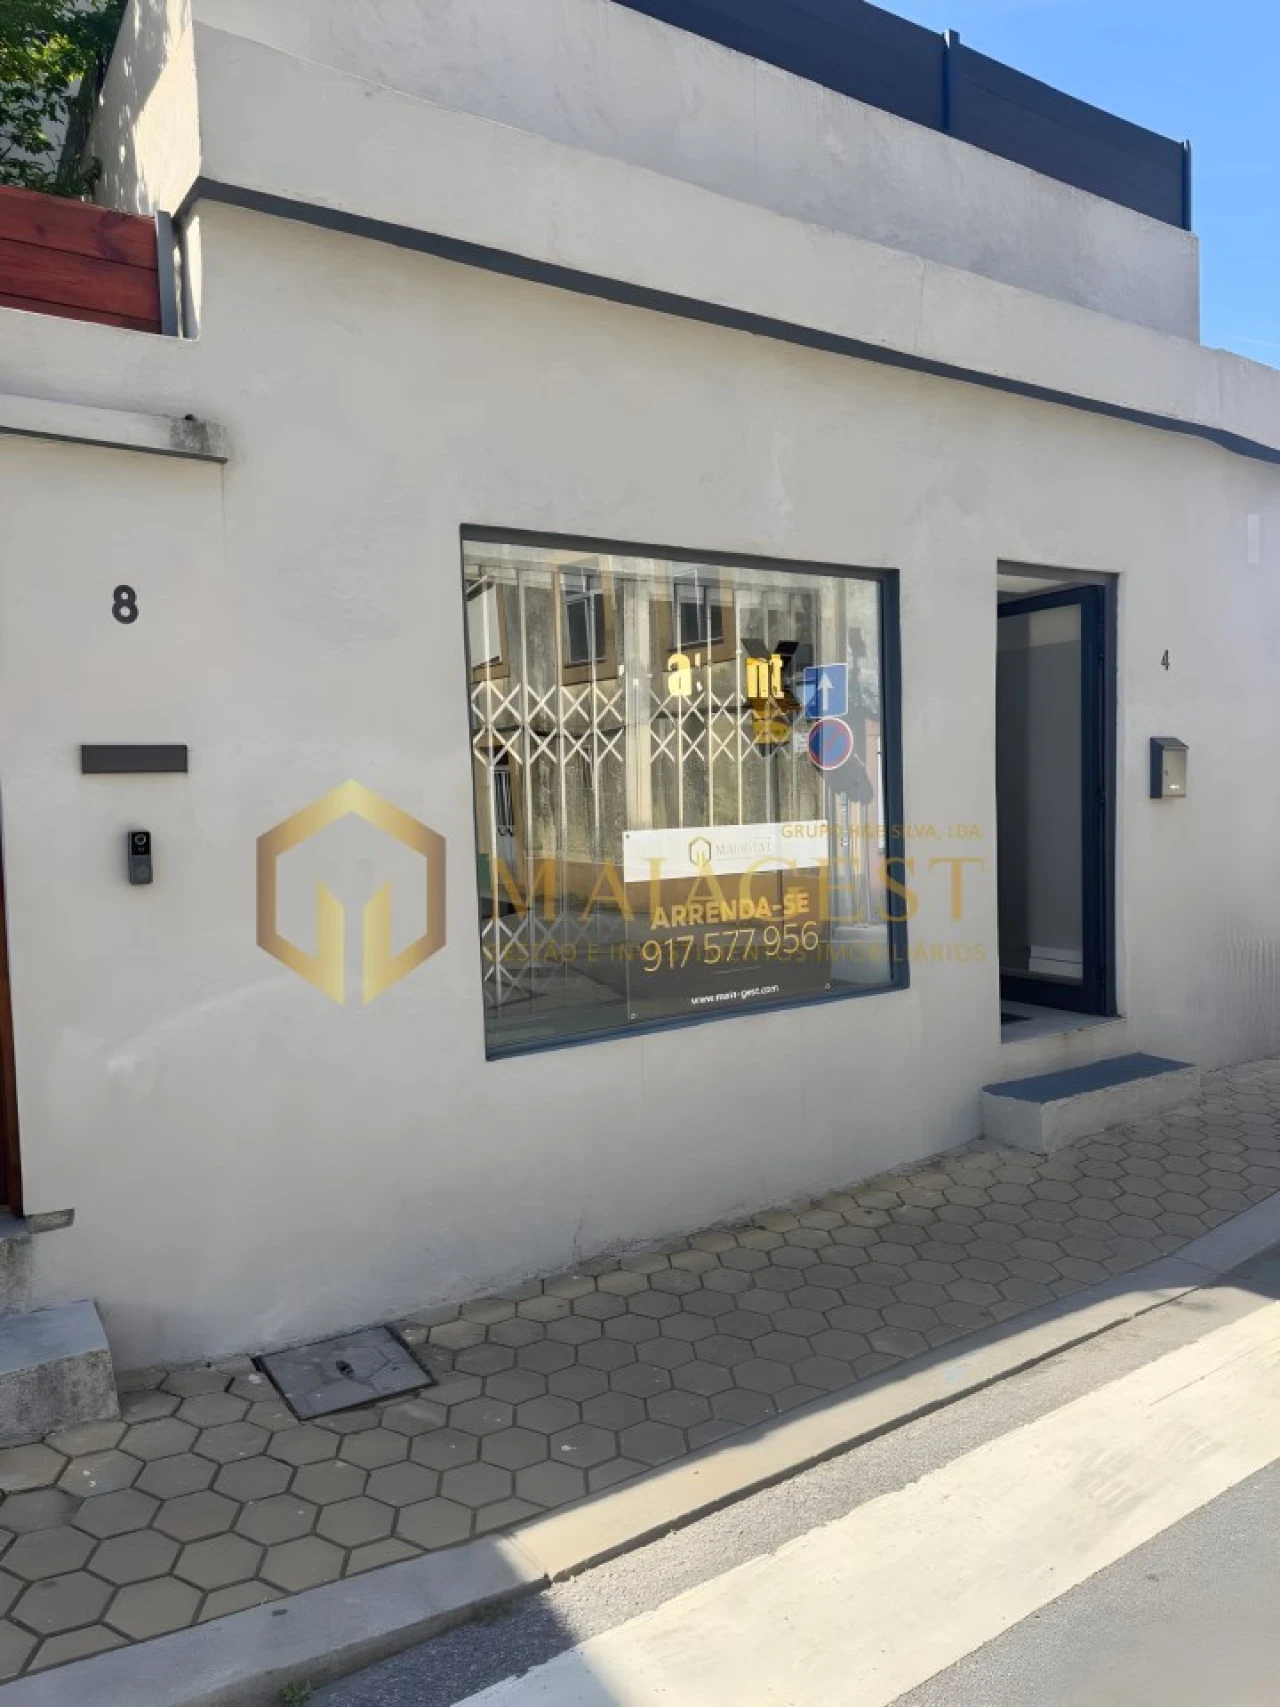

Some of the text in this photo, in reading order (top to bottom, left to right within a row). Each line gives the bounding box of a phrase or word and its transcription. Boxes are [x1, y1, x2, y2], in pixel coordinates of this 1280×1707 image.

[112, 585, 138, 624] 8
[1160, 649, 1170, 670] 4
[651, 890, 810, 931] ARRENDA-SE
[643, 920, 819, 972] 917 577 956
